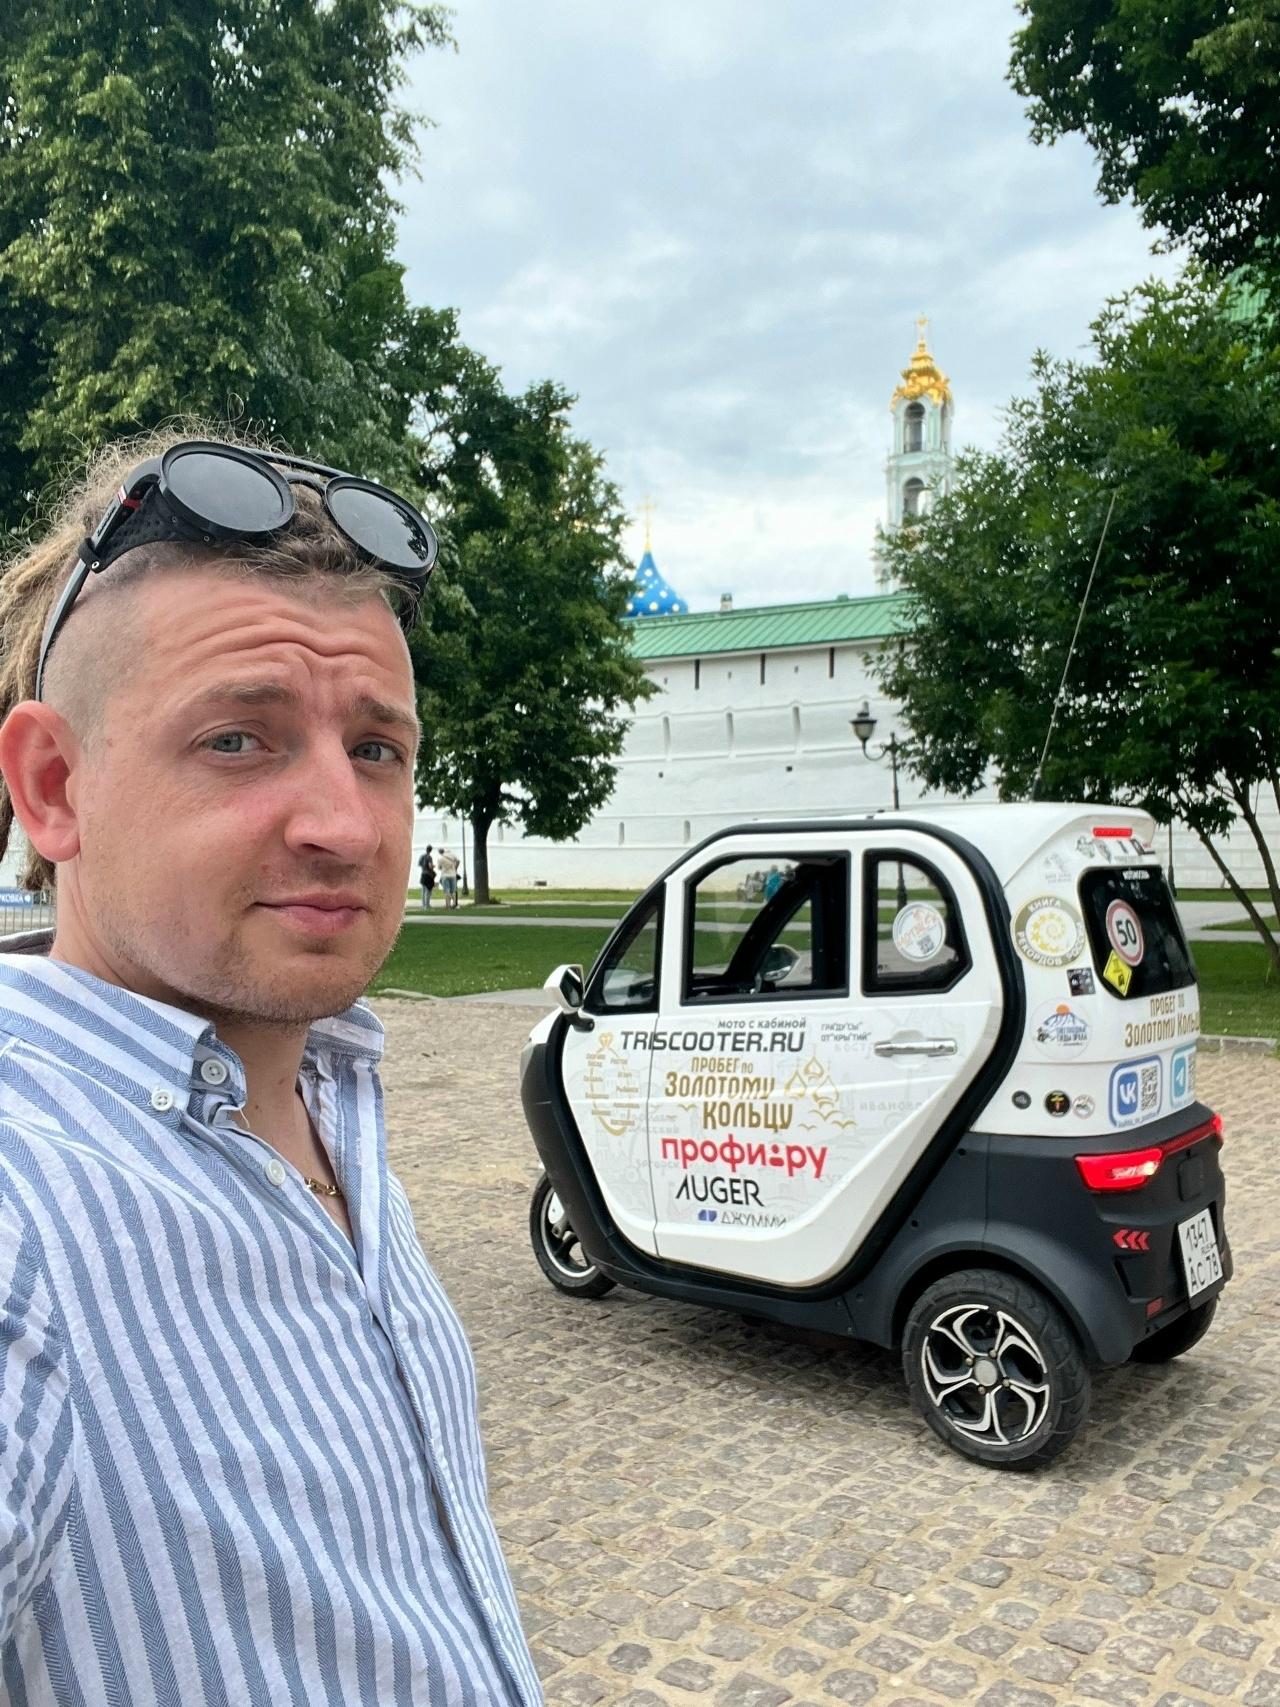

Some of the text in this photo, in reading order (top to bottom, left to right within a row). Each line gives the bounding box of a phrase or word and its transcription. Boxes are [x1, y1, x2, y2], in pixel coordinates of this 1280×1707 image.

[0, 893, 24, 903] КОВКА
[1028, 898, 1061, 913] КНИГА
[1115, 918, 1137, 947] 50
[1016, 931, 1063, 966] РЕКОРДОВ
[1150, 994, 1176, 1017] ПРОБЕГ
[620, 1030, 805, 1053] TRISCOOTER.RU
[691, 1057, 740, 1073] ПРОБЕГ
[703, 1101, 793, 1134] КОЛЬЦУ
[675, 1174, 765, 1207] AUGER
[721, 1211, 787, 1229] ДЖУММИ
[1185, 1217, 1209, 1252] 1347
[1205, 1252, 1219, 1281] 78
